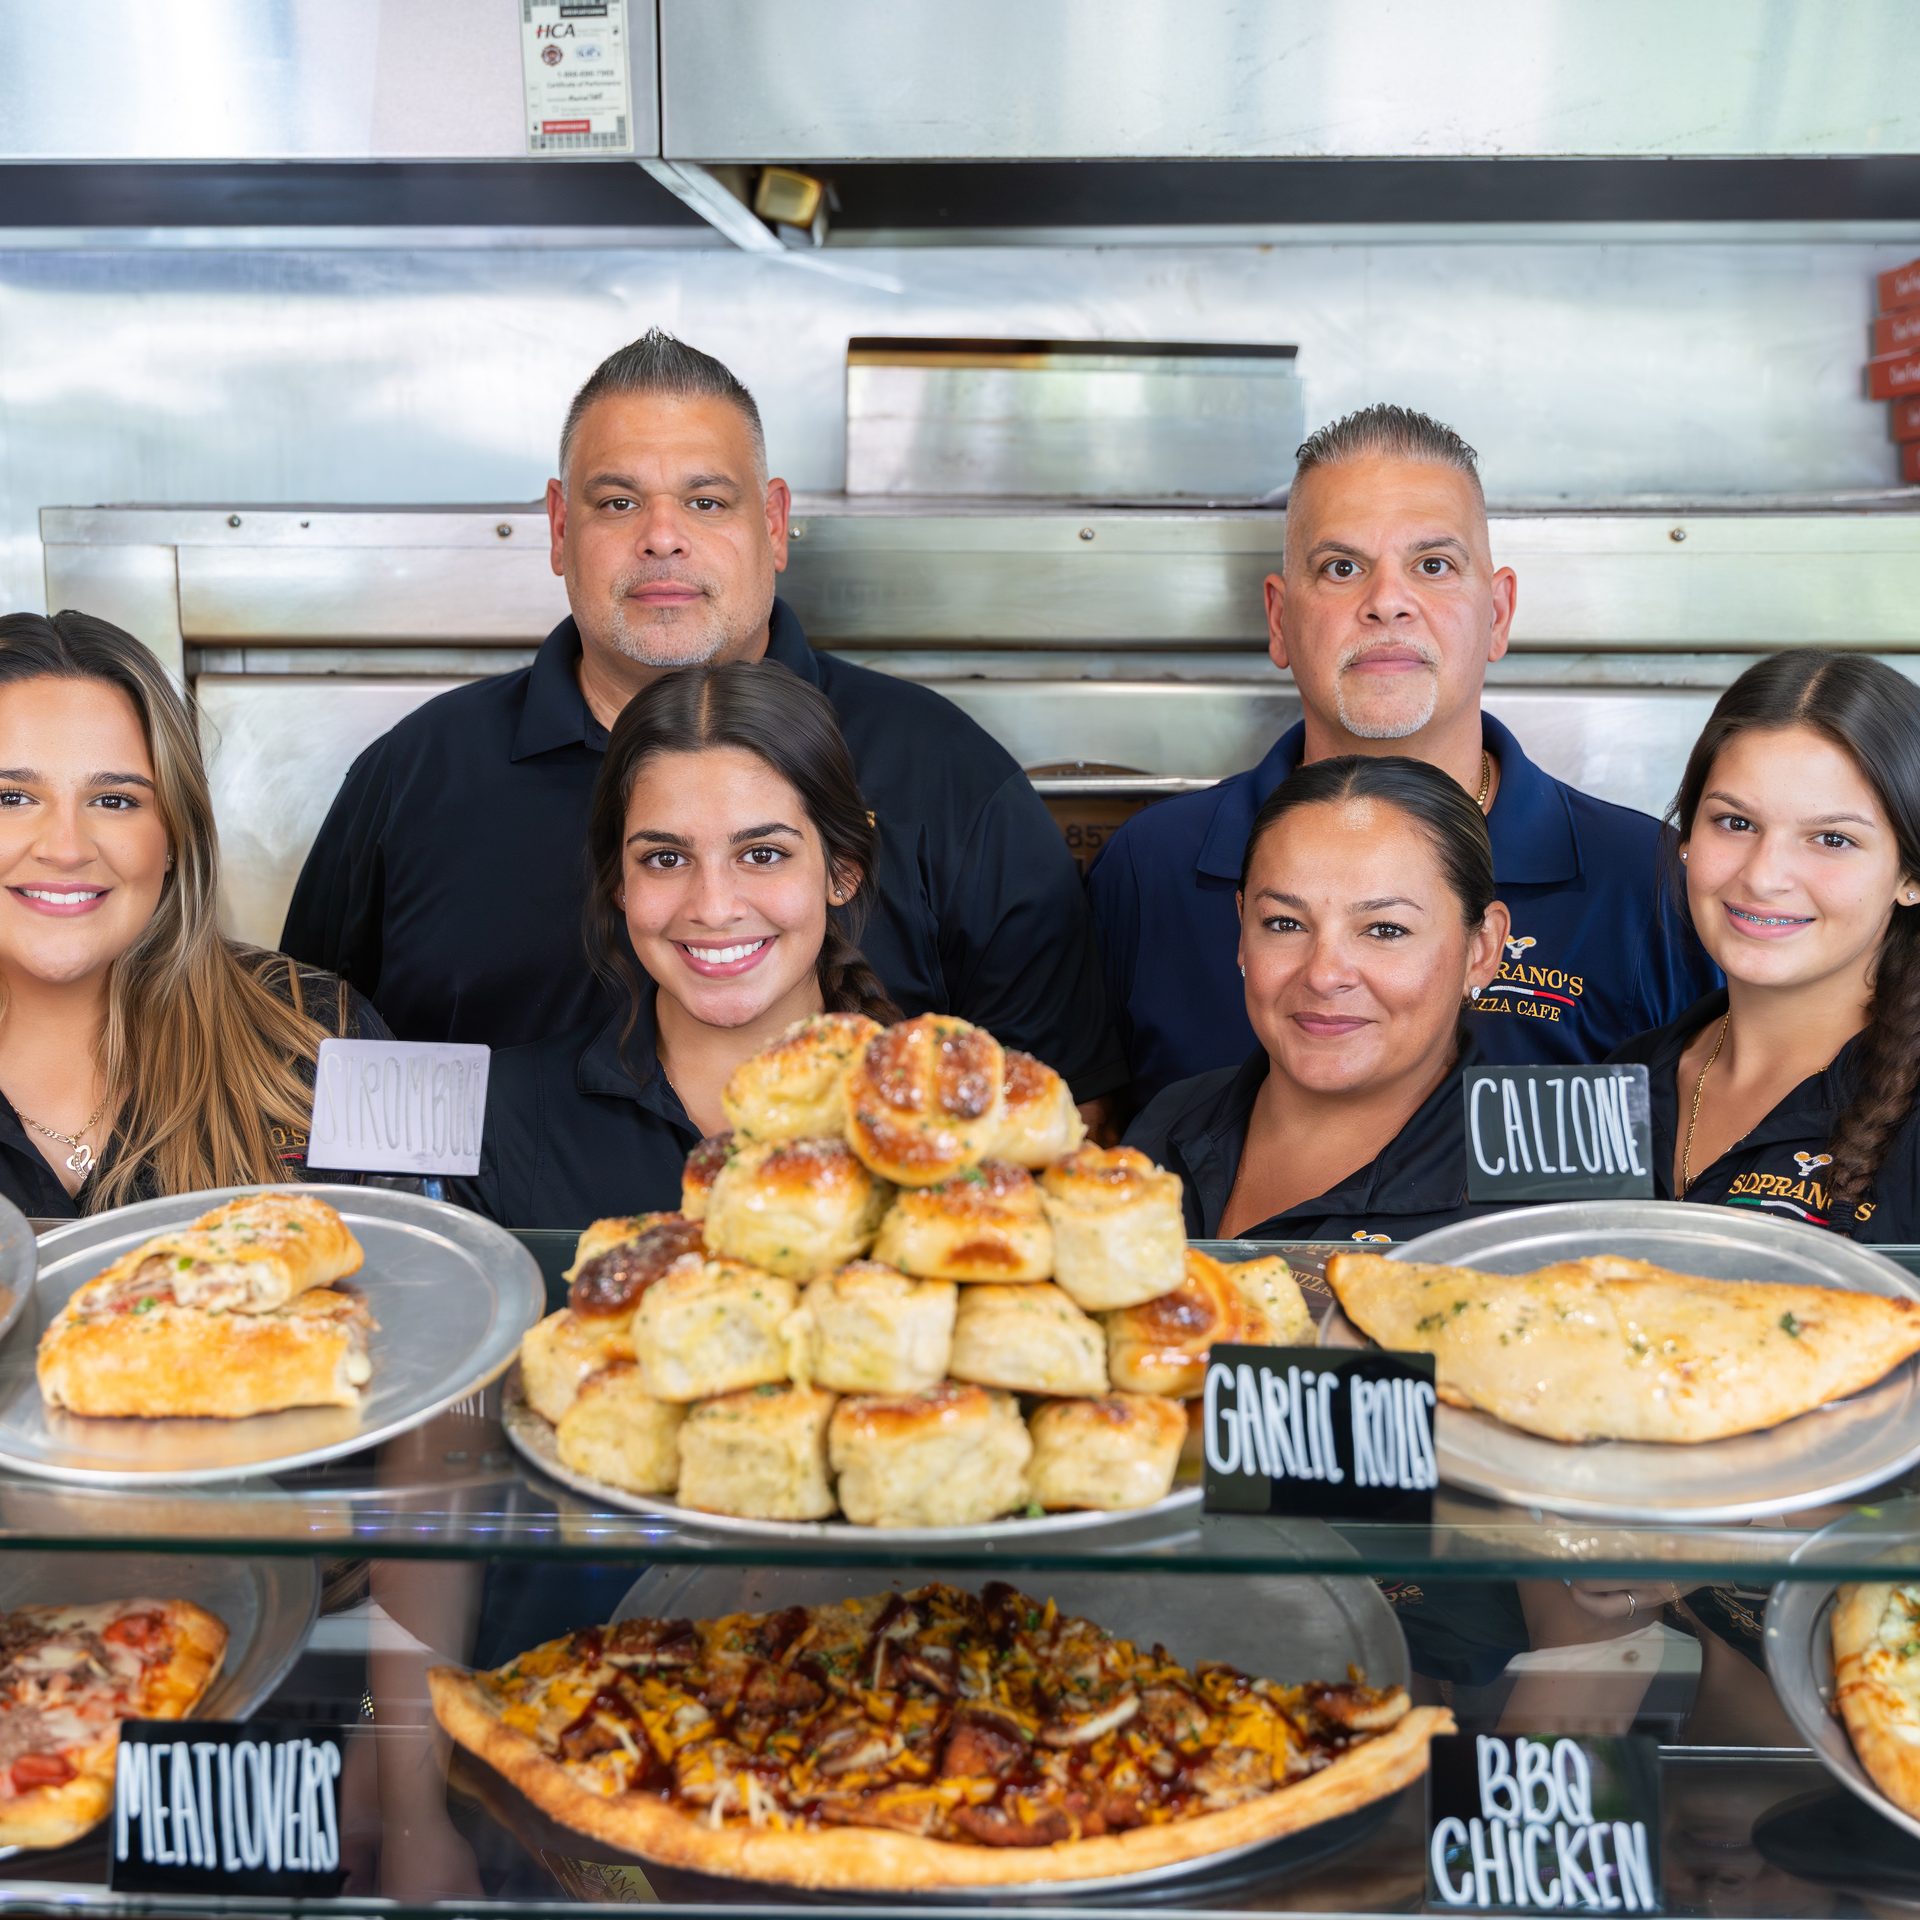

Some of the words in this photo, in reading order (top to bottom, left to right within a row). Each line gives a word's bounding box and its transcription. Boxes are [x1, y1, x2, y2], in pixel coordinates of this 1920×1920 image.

[536, 23, 576, 39] HCA
[1494, 961, 1584, 997] RANO'S
[1516, 1000, 1561, 1022] CAFE
[1470, 1075, 1647, 1176] CALZONE
[1350, 1374, 1438, 1490] ROLLS
[1476, 1734, 1595, 1826] BBQ
